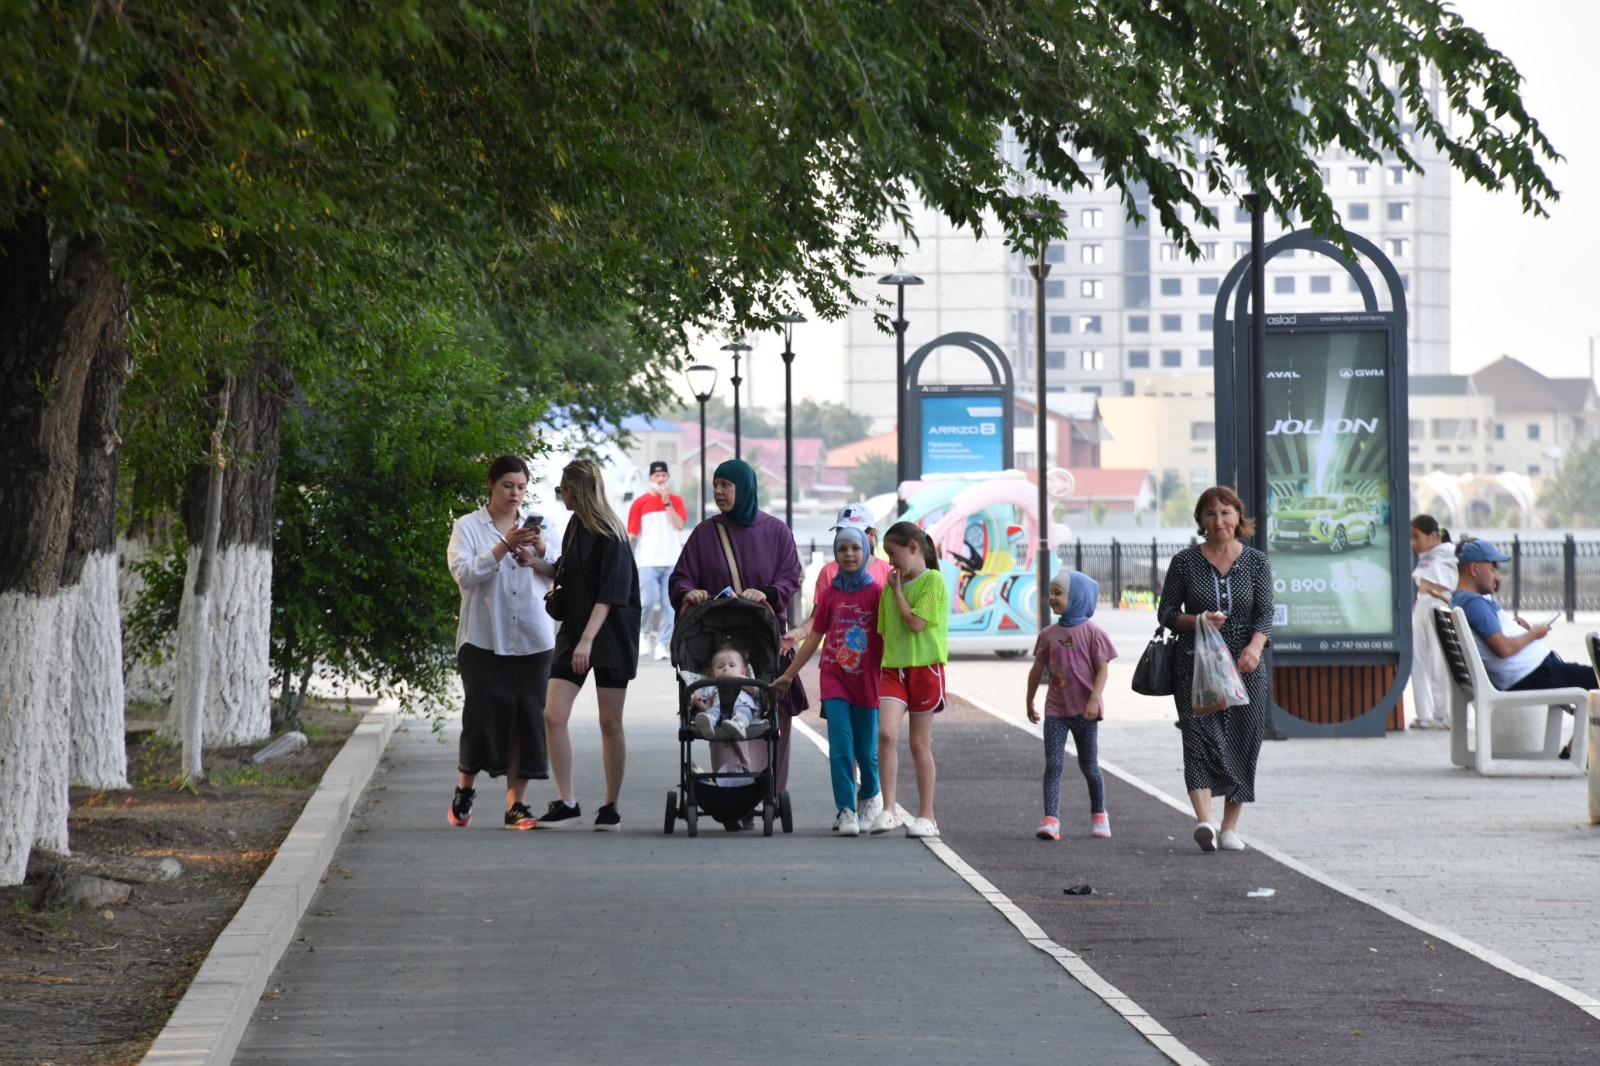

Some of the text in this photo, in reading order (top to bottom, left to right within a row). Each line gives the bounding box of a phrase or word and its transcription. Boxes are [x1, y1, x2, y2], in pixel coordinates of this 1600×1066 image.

[1343, 315, 1360, 323] digital
[1267, 371, 1300, 379] AVAL
[1355, 369, 1385, 377] GWM
[928, 422, 996, 435] ARRIZO 8
[1266, 418, 1379, 435] JOLION
[1291, 579, 1326, 592] 890
[1330, 579, 1367, 592] 000
[1331, 641, 1340, 649] +7
[1341, 641, 1354, 649] 747
